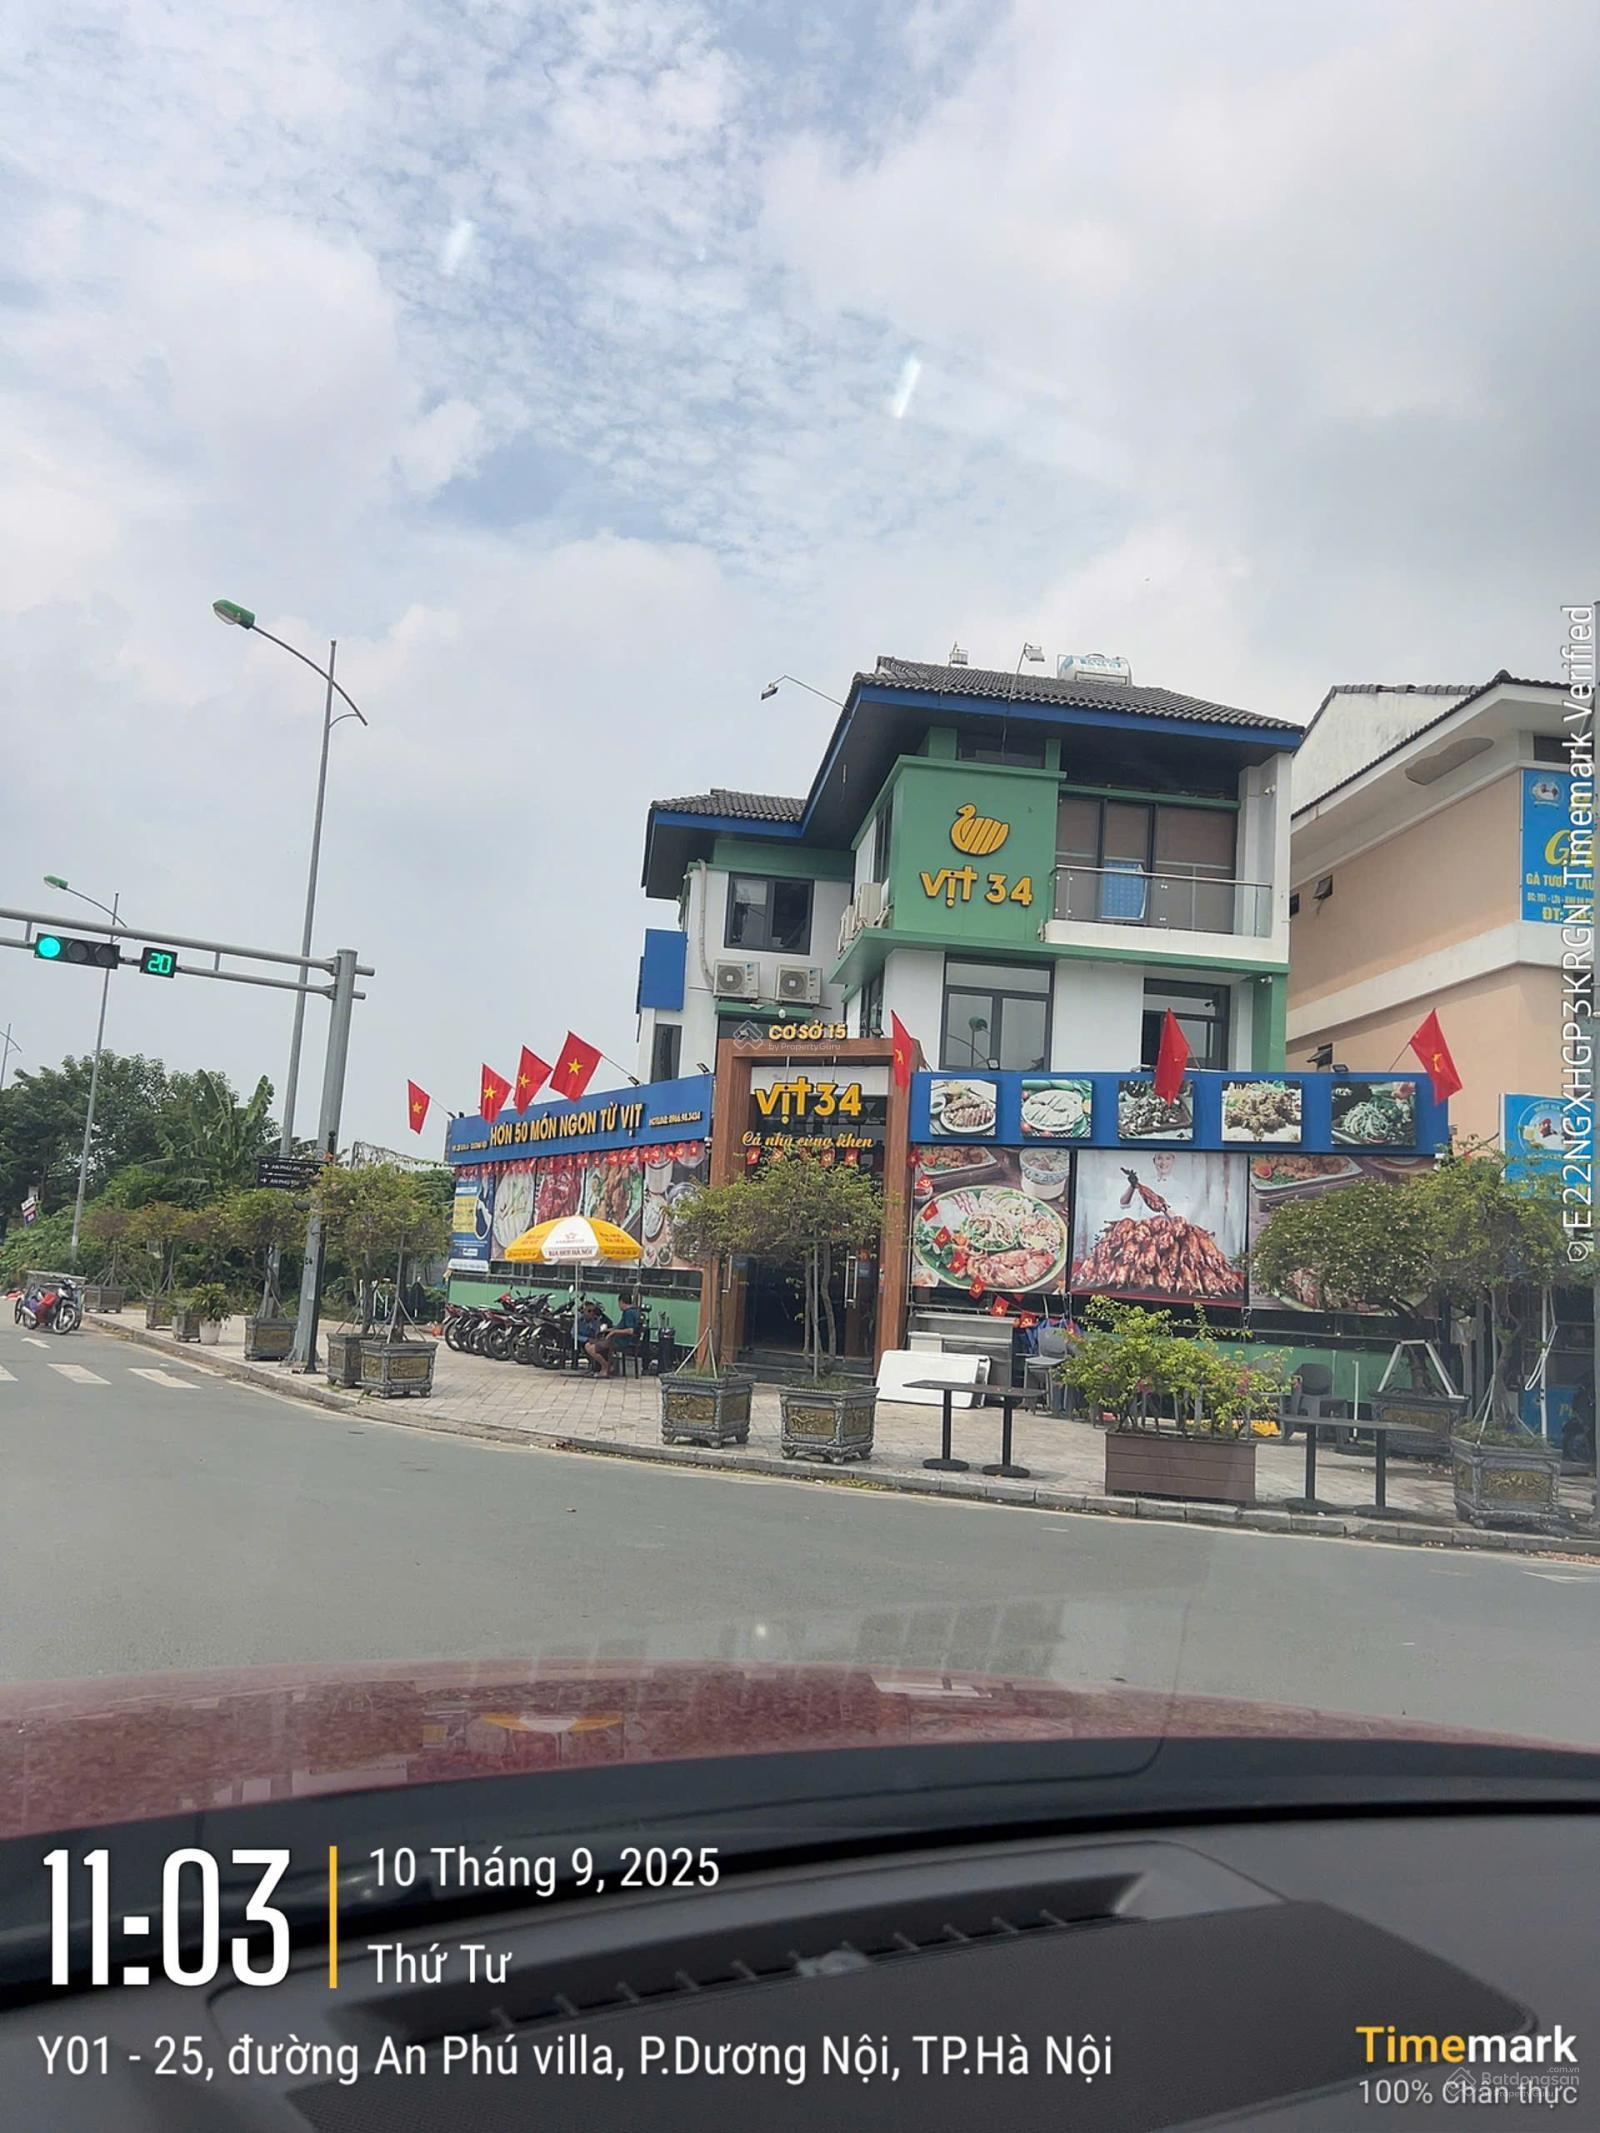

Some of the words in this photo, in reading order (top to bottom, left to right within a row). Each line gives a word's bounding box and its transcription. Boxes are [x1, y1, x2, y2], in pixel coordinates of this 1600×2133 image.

[985, 871, 1033, 906] 34
[147, 952, 172, 975] 20
[769, 1023, 797, 1040] CƠ
[798, 1020, 823, 1040] SỞ
[828, 1023, 847, 1039] 15
[814, 1083, 862, 1118] 34
[490, 1121, 512, 1146] HƠN
[515, 1123, 527, 1143] 50
[530, 1112, 557, 1141] MÓN
[560, 1110, 597, 1138] NGON
[600, 1100, 618, 1132] TỪ
[620, 1103, 643, 1136] VỊT
[742, 1131, 762, 1146] Cả
[836, 1133, 873, 1148] khen
